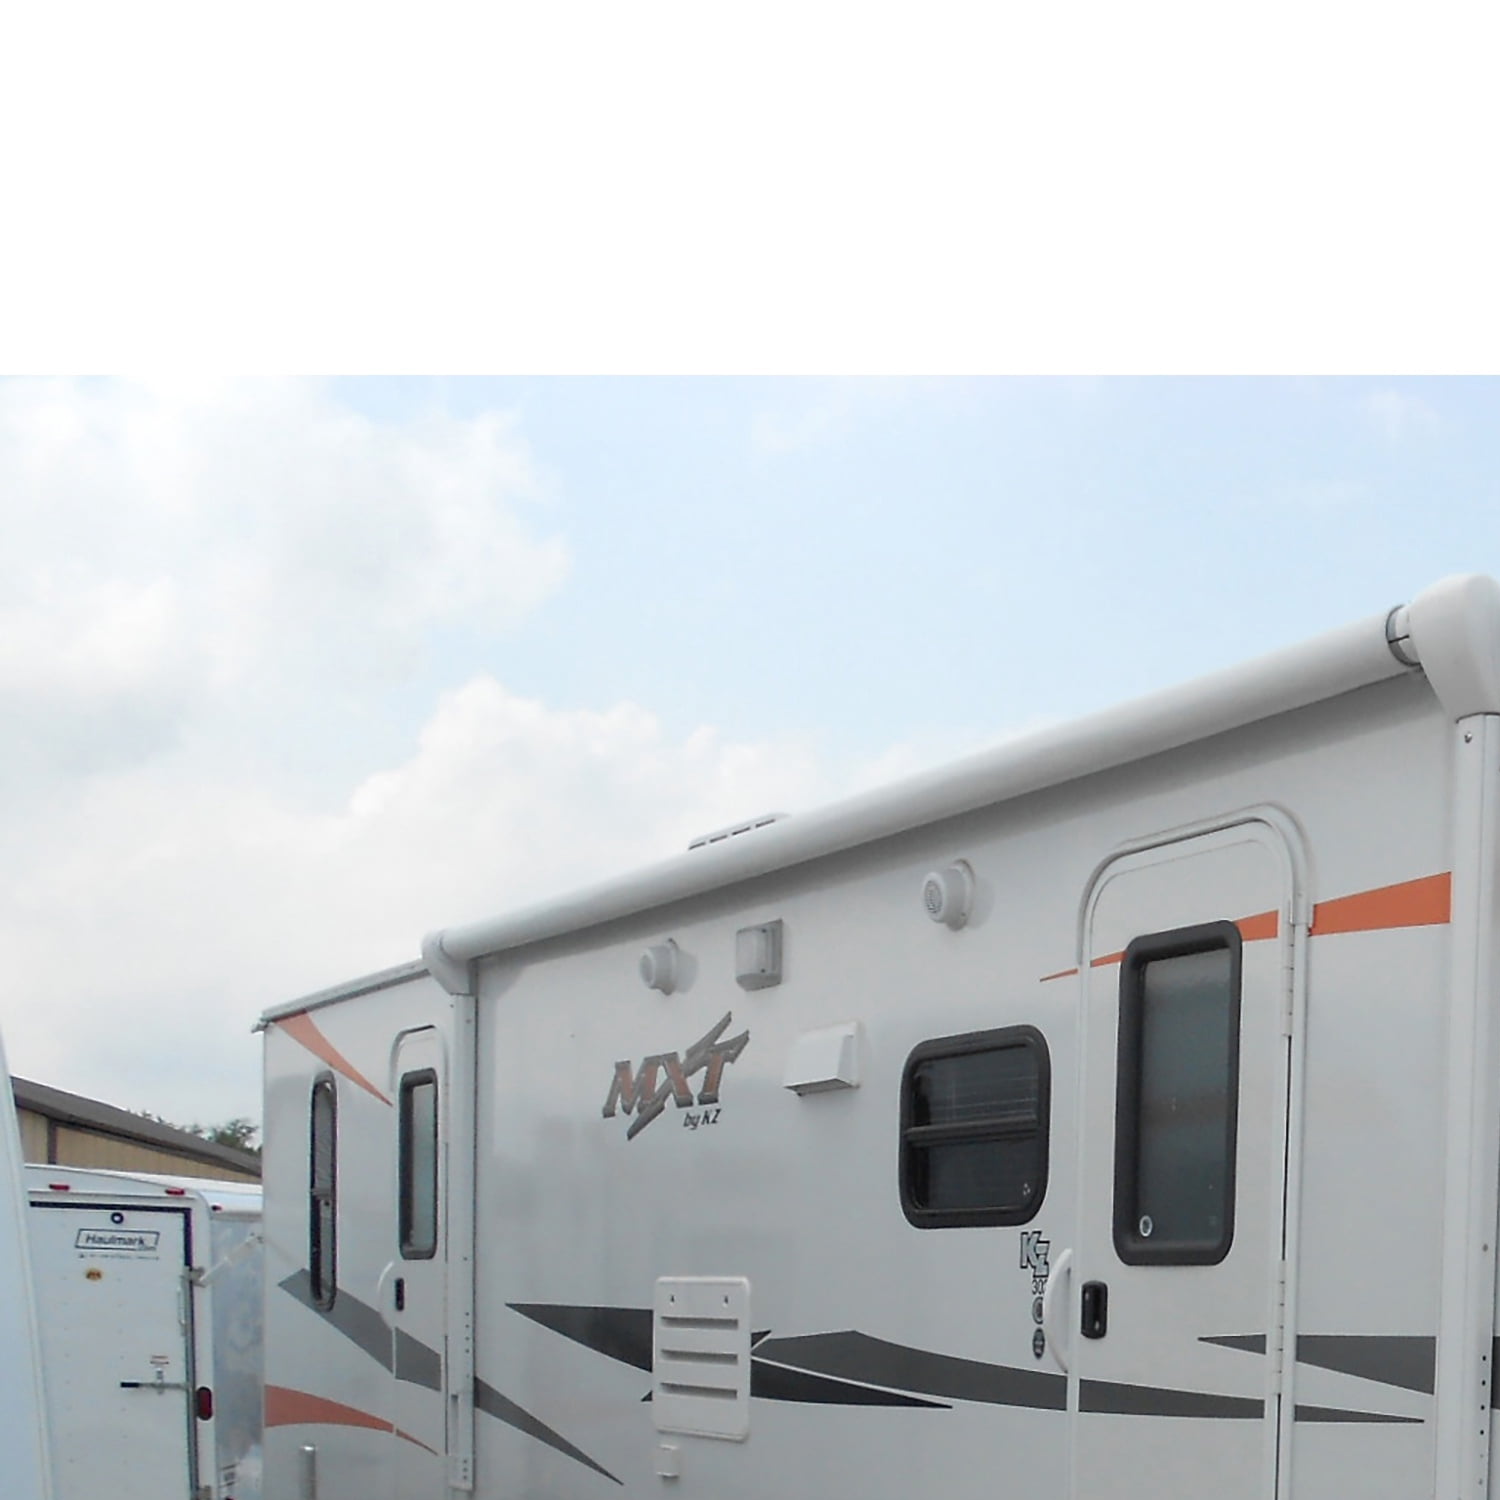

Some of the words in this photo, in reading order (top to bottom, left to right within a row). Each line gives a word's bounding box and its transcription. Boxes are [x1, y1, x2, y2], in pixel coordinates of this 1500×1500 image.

[602, 1011, 750, 1141] MXT
[683, 1111, 700, 1130] by
[701, 1108, 722, 1125] KZ
[85, 1234, 145, 1246] Haulmark
